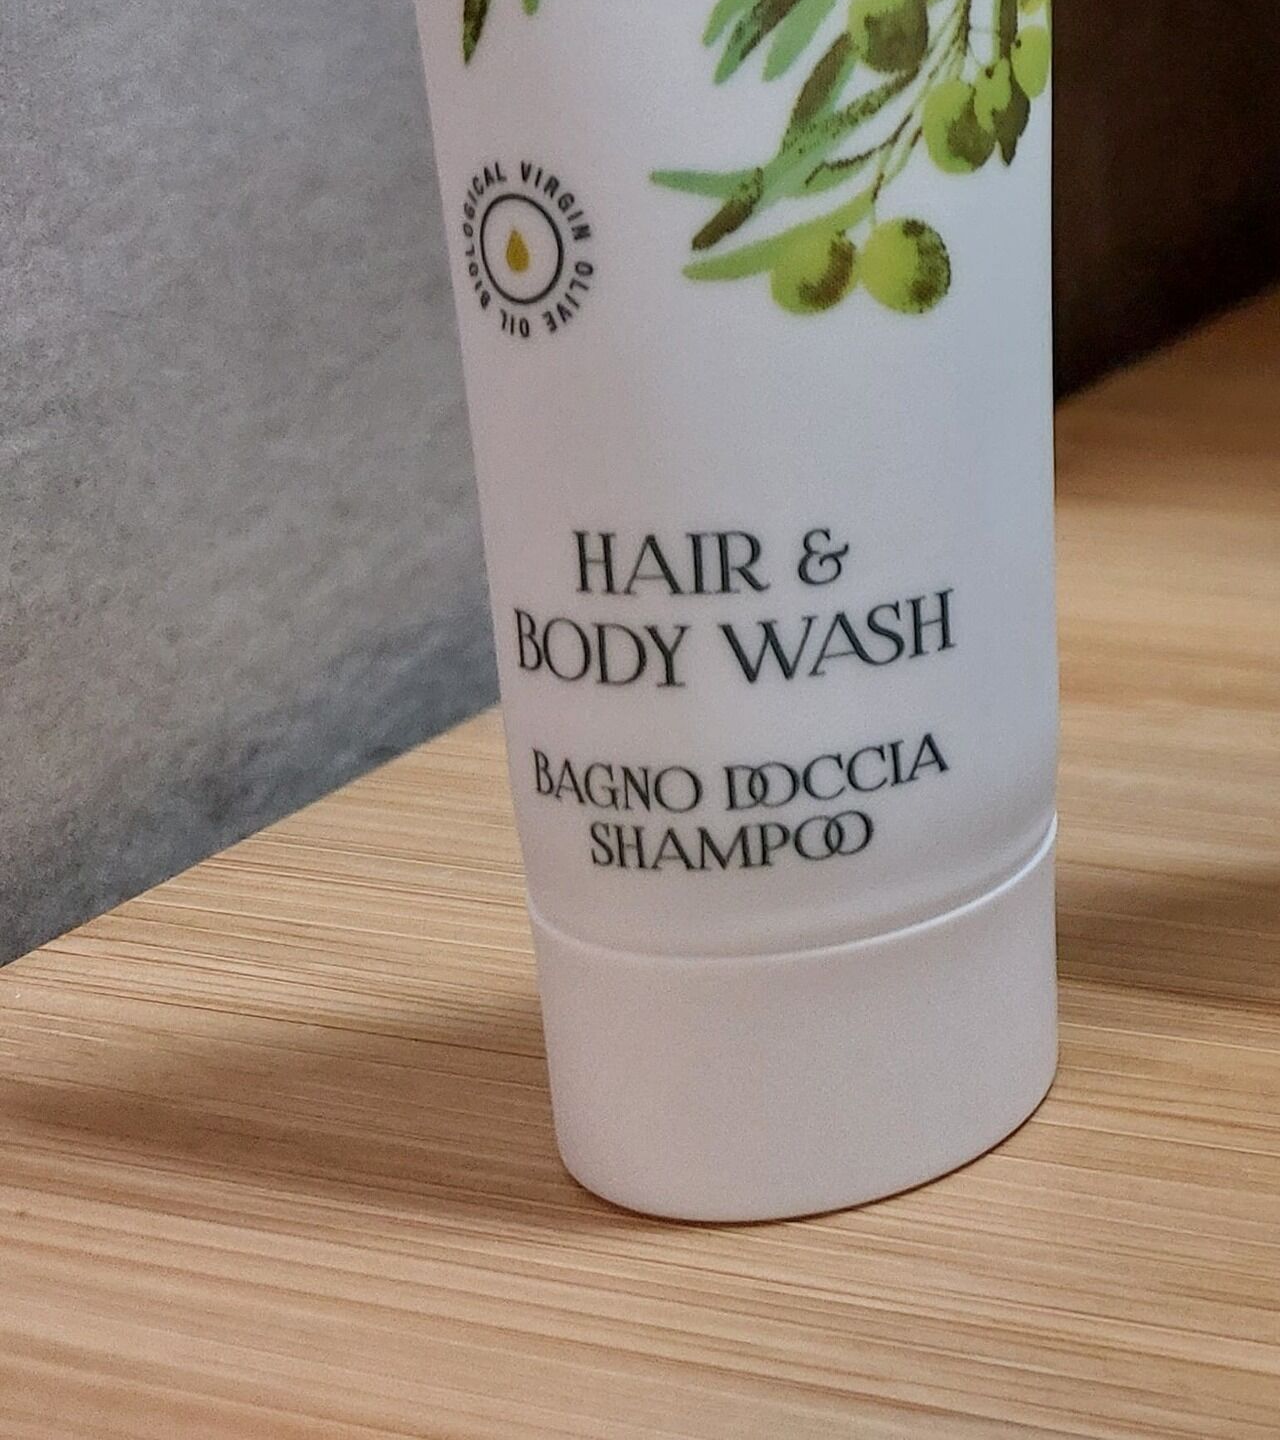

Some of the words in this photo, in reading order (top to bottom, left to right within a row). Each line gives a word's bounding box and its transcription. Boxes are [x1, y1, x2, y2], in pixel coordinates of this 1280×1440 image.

[462, 162, 508, 309] BIOLOGICAL
[520, 160, 592, 241] VIRGIN
[500, 309, 530, 338] OIL
[542, 261, 594, 333] OLIVE
[571, 528, 770, 596] HAIR
[797, 527, 850, 586] &
[513, 607, 692, 689] BODY
[717, 587, 956, 685] WASH
[532, 746, 704, 814] BAGNO
[724, 732, 951, 811] DOCCIA
[590, 809, 875, 872] SHAMPOO
